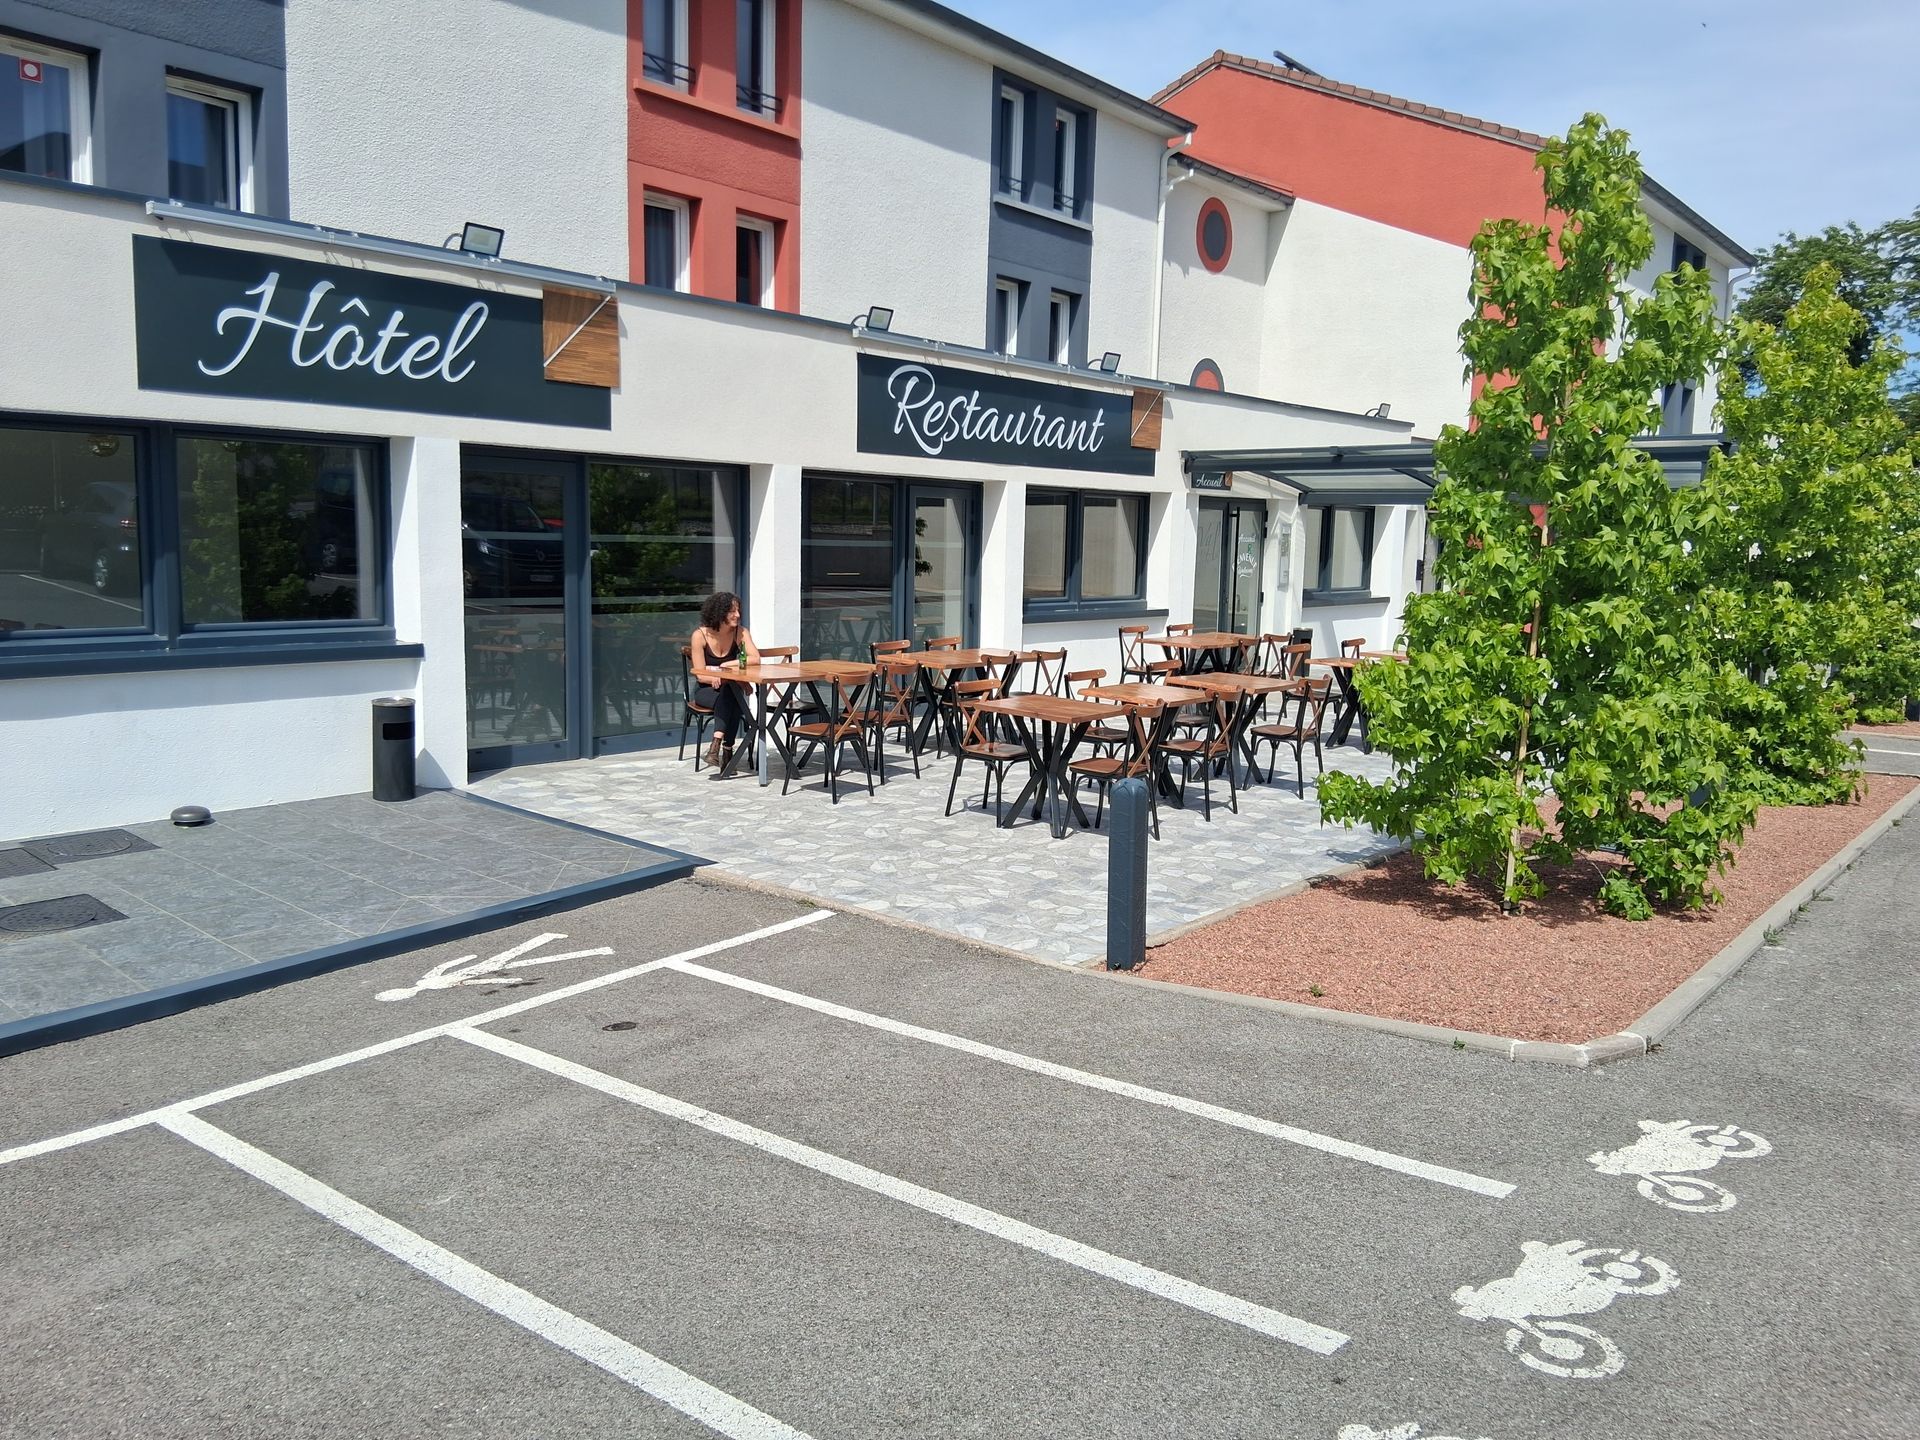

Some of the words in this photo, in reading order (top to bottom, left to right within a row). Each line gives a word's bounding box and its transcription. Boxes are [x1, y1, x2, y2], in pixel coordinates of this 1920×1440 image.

[197, 271, 490, 384] Hôtel
[887, 364, 1106, 456] Restaurant
[1195, 473, 1224, 488] Accueil
